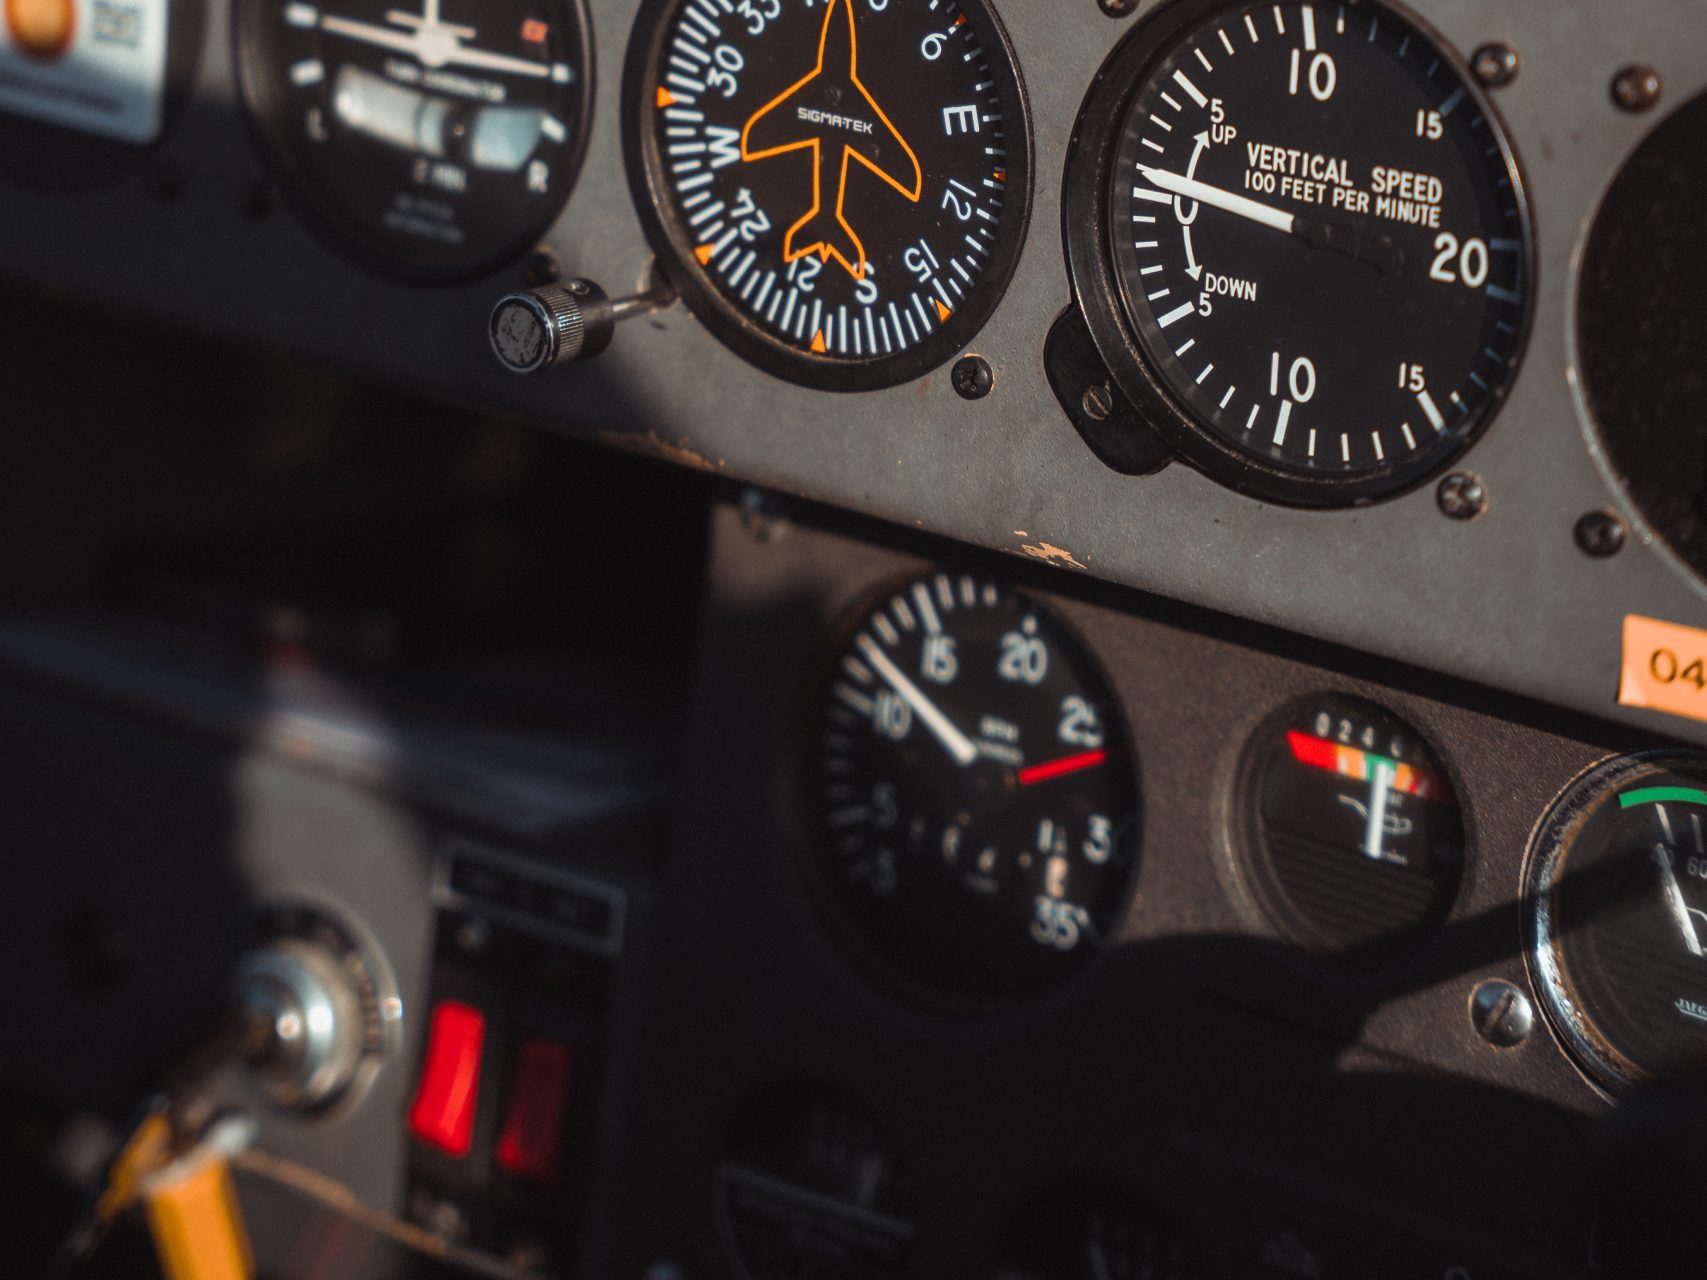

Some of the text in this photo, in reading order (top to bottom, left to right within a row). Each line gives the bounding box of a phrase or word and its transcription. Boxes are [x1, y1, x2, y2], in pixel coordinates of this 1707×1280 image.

[920, 32, 948, 60] 6
[706, 44, 744, 97] 30
[1289, 47, 1338, 101] 10
[943, 103, 981, 136] E
[1210, 98, 1225, 123] 5
[1415, 108, 1444, 141] 15
[706, 125, 742, 168] W
[1211, 123, 1238, 145] UP
[526, 158, 550, 195] R
[1246, 140, 1443, 205] VERTICAL SPEED
[730, 187, 771, 241] 24
[941, 179, 977, 221] 12
[1244, 169, 1442, 228] 100 FEET PER MINUTE
[786, 252, 823, 293] 21
[903, 238, 940, 283] 15
[1429, 232, 1490, 289] 20
[852, 261, 878, 305] S
[1205, 272, 1258, 303] DOWN
[1197, 292, 1213, 318] 5
[1269, 350, 1318, 404] 10
[1399, 361, 1427, 395] 15
[921, 634, 958, 684] 15
[999, 631, 1049, 685] 20
[872, 687, 913, 742] 10
[1315, 711, 1331, 738] 0
[1337, 718, 1353, 744] 2
[1360, 725, 1376, 749] 4
